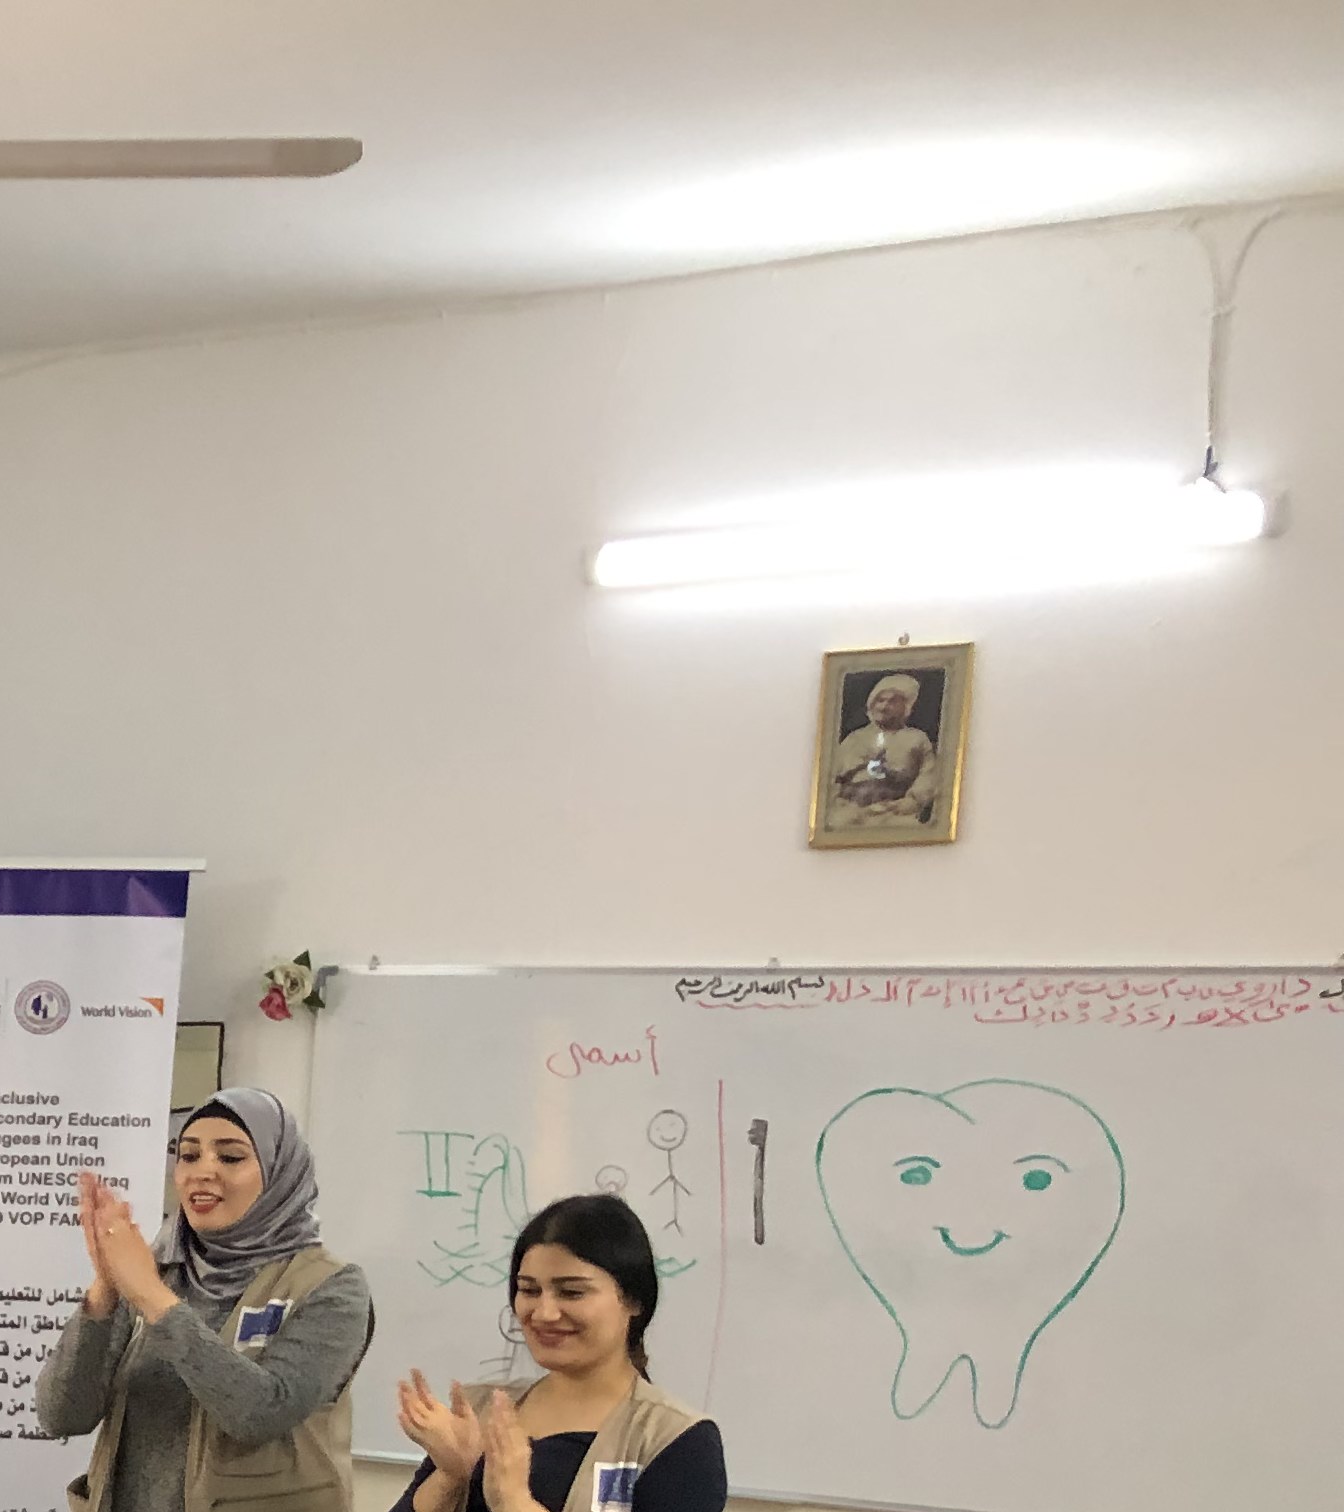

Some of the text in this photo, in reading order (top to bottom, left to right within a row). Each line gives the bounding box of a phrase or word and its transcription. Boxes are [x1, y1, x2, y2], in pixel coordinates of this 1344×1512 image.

[80, 1004, 152, 1019] World Vision
[67, 1112, 152, 1128] Education
[46, 1131, 62, 1146] in
[66, 1132, 99, 1150] Iraq
[56, 1152, 106, 1167] Union
[17, 1172, 79, 1187] UNESC
[97, 1174, 130, 1191] Iraq
[1, 1191, 50, 1206] World
[55, 1192, 80, 1207] Vis
[8, 1210, 45, 1226] VOP
[47, 1286, 84, 1306] شامل
[13, 1342, 32, 1361] من
[12, 1370, 32, 1389] من
[6, 1398, 26, 1417] من
